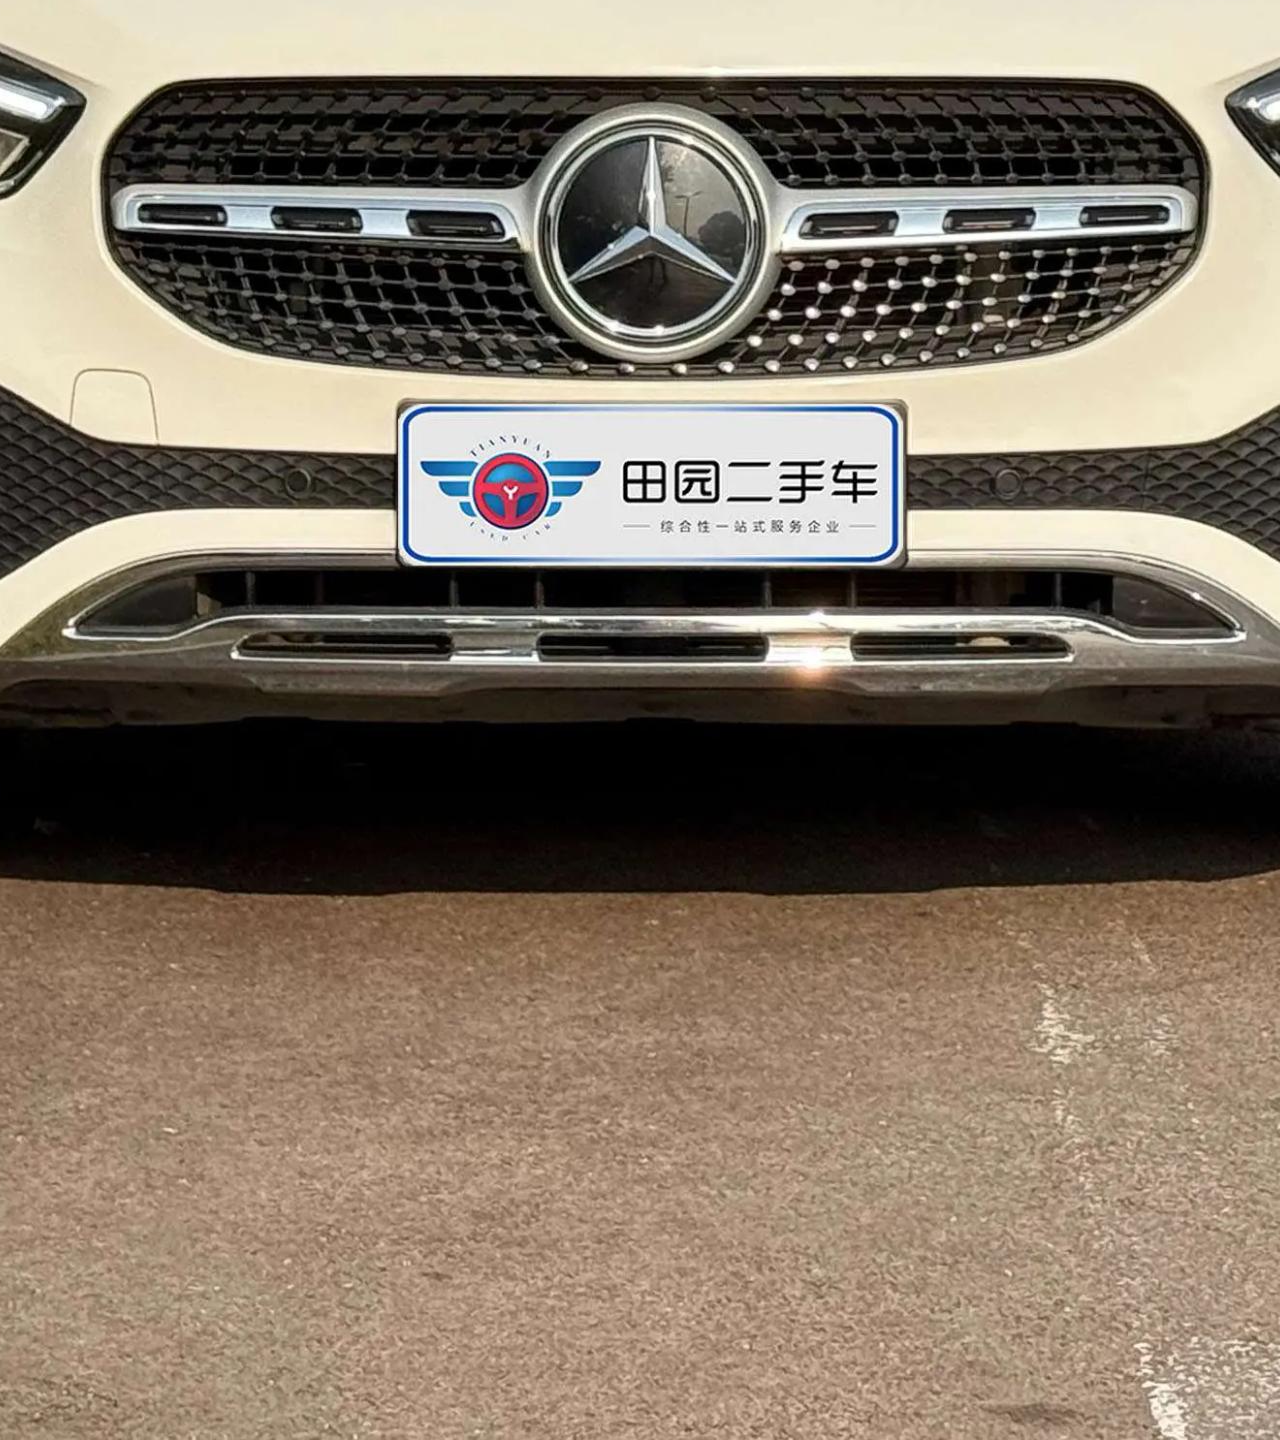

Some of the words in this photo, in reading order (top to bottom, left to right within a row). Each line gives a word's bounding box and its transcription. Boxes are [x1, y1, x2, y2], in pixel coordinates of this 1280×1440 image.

[623, 460, 878, 504] 田园二手车
[660, 520, 839, 534] 综合性一站式服务企业
